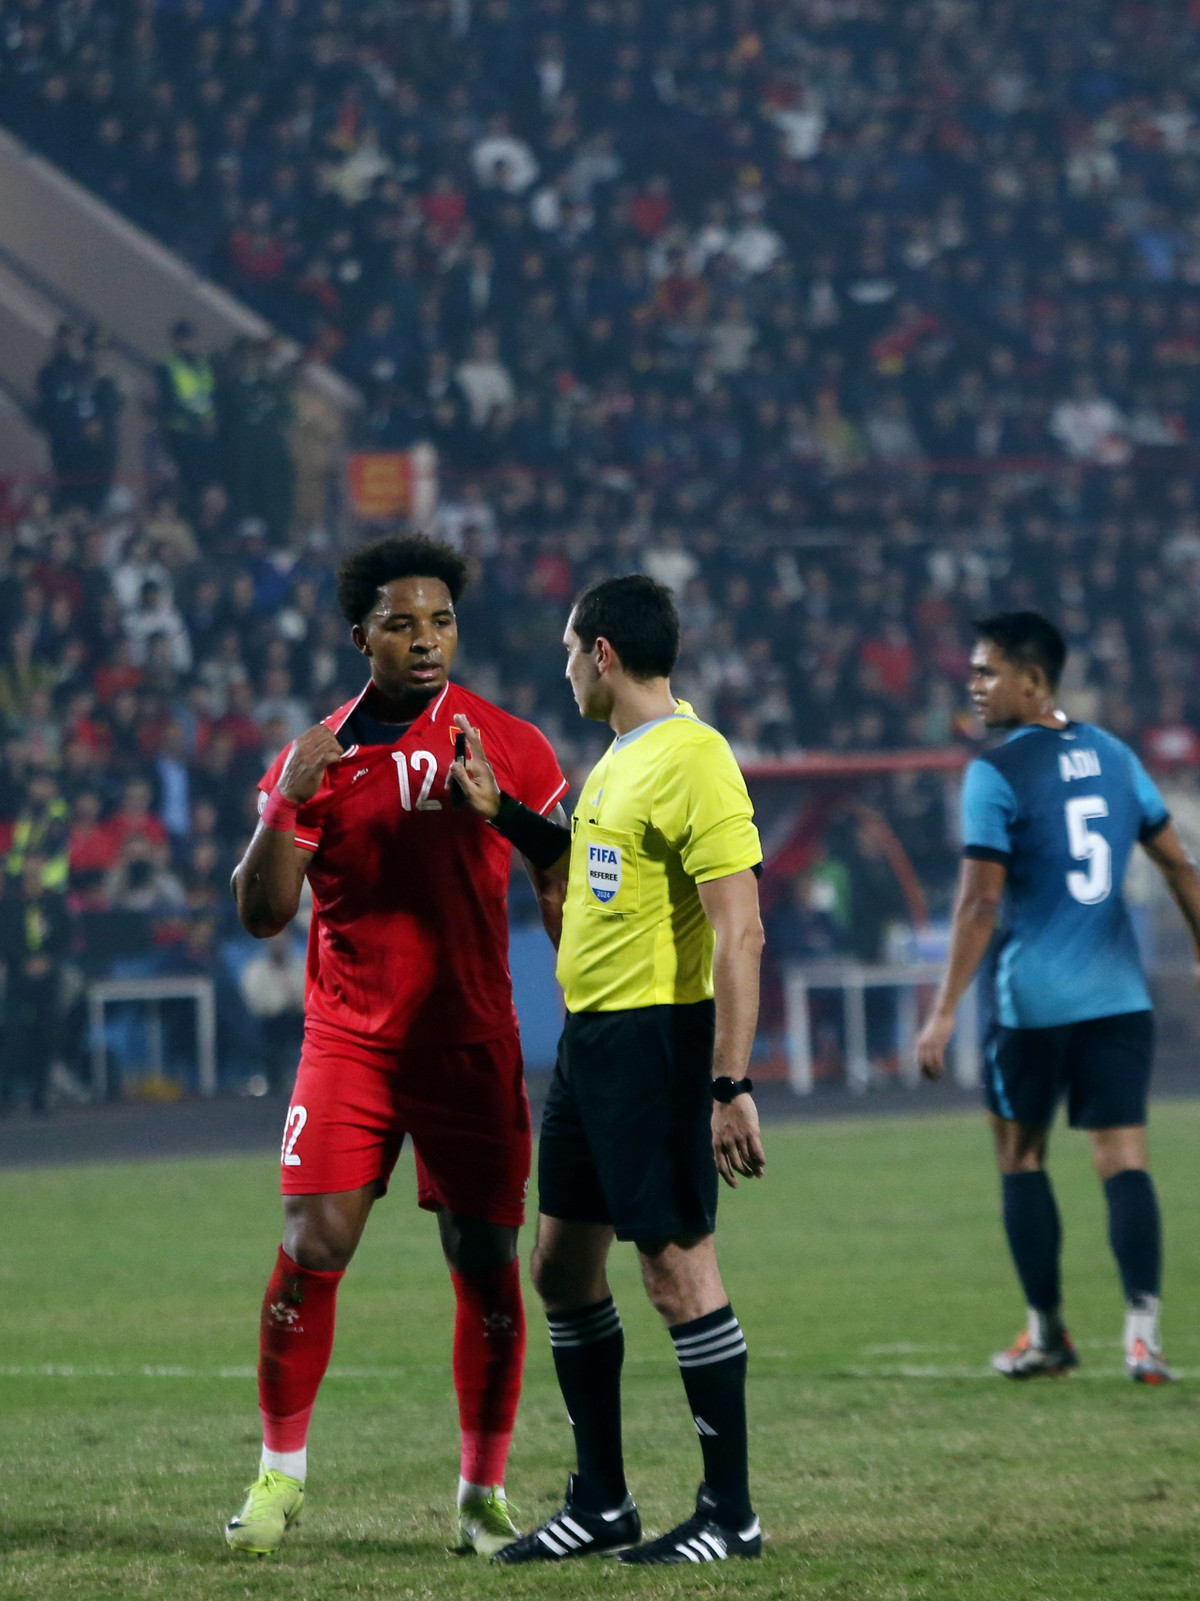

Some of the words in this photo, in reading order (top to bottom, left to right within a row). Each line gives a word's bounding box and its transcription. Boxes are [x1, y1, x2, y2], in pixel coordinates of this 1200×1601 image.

[391, 750, 443, 812] 12
[590, 847, 618, 865] FIFA
[1065, 795, 1112, 905] 5
[590, 870, 618, 881] REFEREE
[597, 890, 611, 899] 2024
